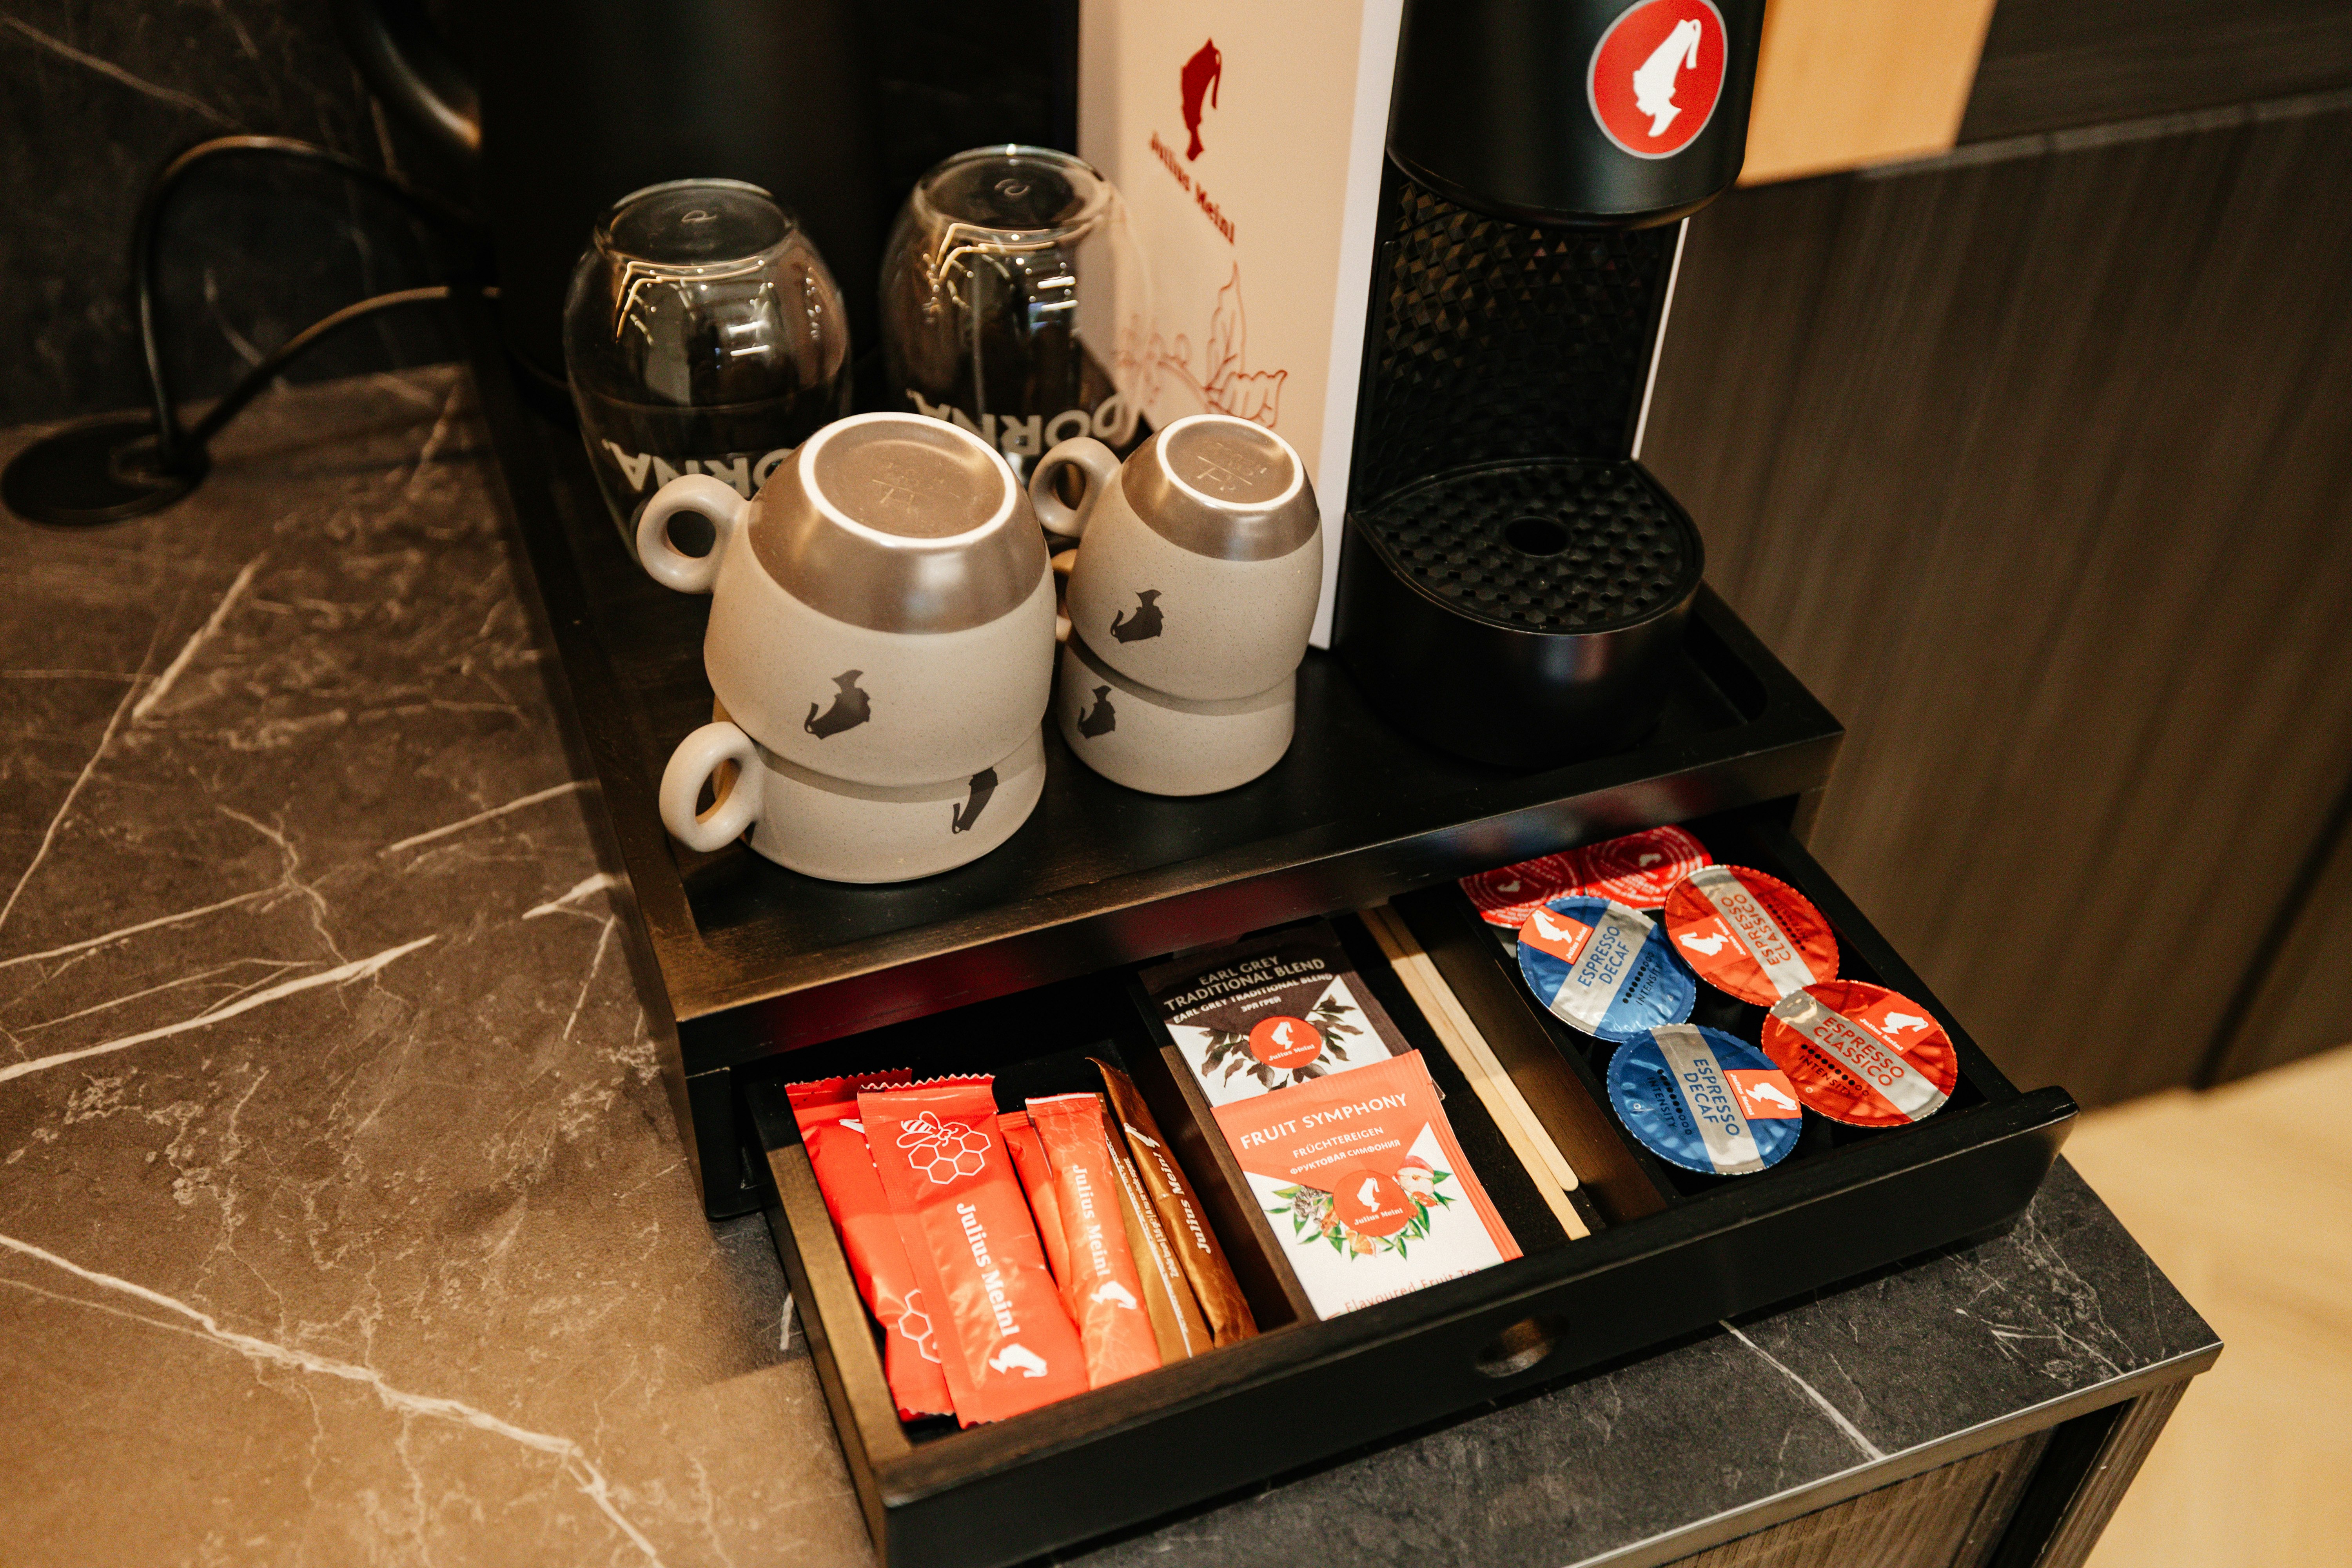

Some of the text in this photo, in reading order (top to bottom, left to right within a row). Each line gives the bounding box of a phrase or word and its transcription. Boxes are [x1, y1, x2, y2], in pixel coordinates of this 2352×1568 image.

[1195, 181, 1235, 246] Meinl
[1566, 927, 1588, 959] Julius Meinl
[1721, 896, 1780, 965] ESPRESSO
[1734, 894, 1791, 961] CLASSICO
[1198, 955, 1279, 986] EARL GREY
[1577, 926, 1620, 987] ESPRESSO
[1599, 941, 1630, 984] DECAF
[1163, 958, 1325, 1011] TRADITIONAL BLEND
[1173, 973, 1333, 1024] EARL GREY TRADITIONAL BLEND
[1635, 963, 1663, 1005] INTENSITY
[1269, 1044, 1315, 1061] Julius Meinl
[1813, 1026, 1893, 1086] CLASSICO
[1823, 1016, 1904, 1078] ESPRESSO
[1860, 1018, 1904, 1051] Julius Meinl
[1683, 1073, 1719, 1123] DECAF
[1693, 1059, 1740, 1136] ESPRESSO
[1730, 1073, 1755, 1115] Julius Meinl
[1799, 1055, 1850, 1097] INTENSITY
[1240, 1093, 1406, 1150] FRUIT SYMPHONY
[1648, 1077, 1678, 1127] INTENSITY
[1290, 1139, 1401, 1174] ФРУКТОВАЯ СИМФОНИЯ
[1293, 1126, 1384, 1158] FRÜCHTEREIGEN
[1073, 1164, 1111, 1276] Julius Meinl
[1153, 1152, 1211, 1254] Julius Meinl
[1354, 1207, 1403, 1225] Julius Meinl
[956, 1202, 1020, 1338] Julius Meinl
[1344, 1281, 1417, 1313] Flavoured
[1420, 1274, 1454, 1289] Fruit
